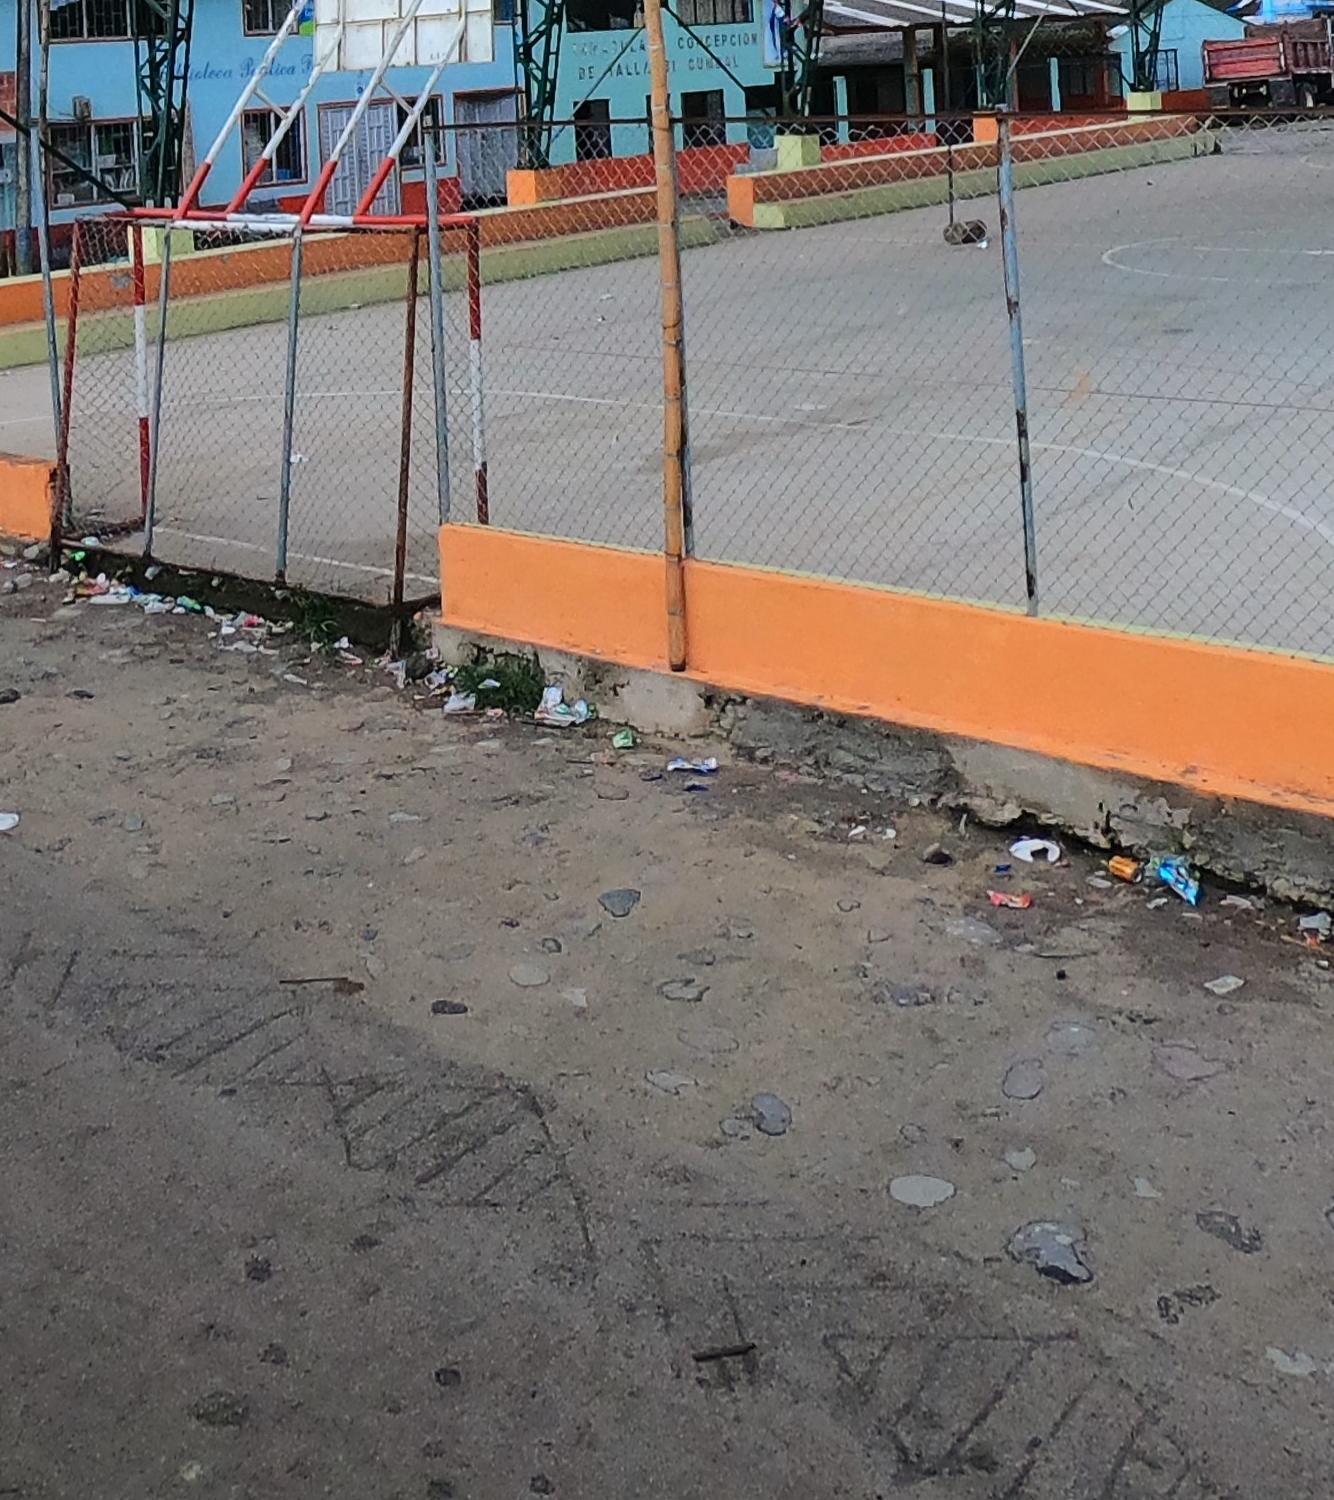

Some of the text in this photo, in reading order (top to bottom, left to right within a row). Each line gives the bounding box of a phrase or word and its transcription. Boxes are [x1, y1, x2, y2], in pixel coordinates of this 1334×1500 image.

[677, 33, 758, 50] COCEPCION
[240, 57, 296, 78] Plica
[579, 55, 739, 80] DE ALLAI CUMAL
